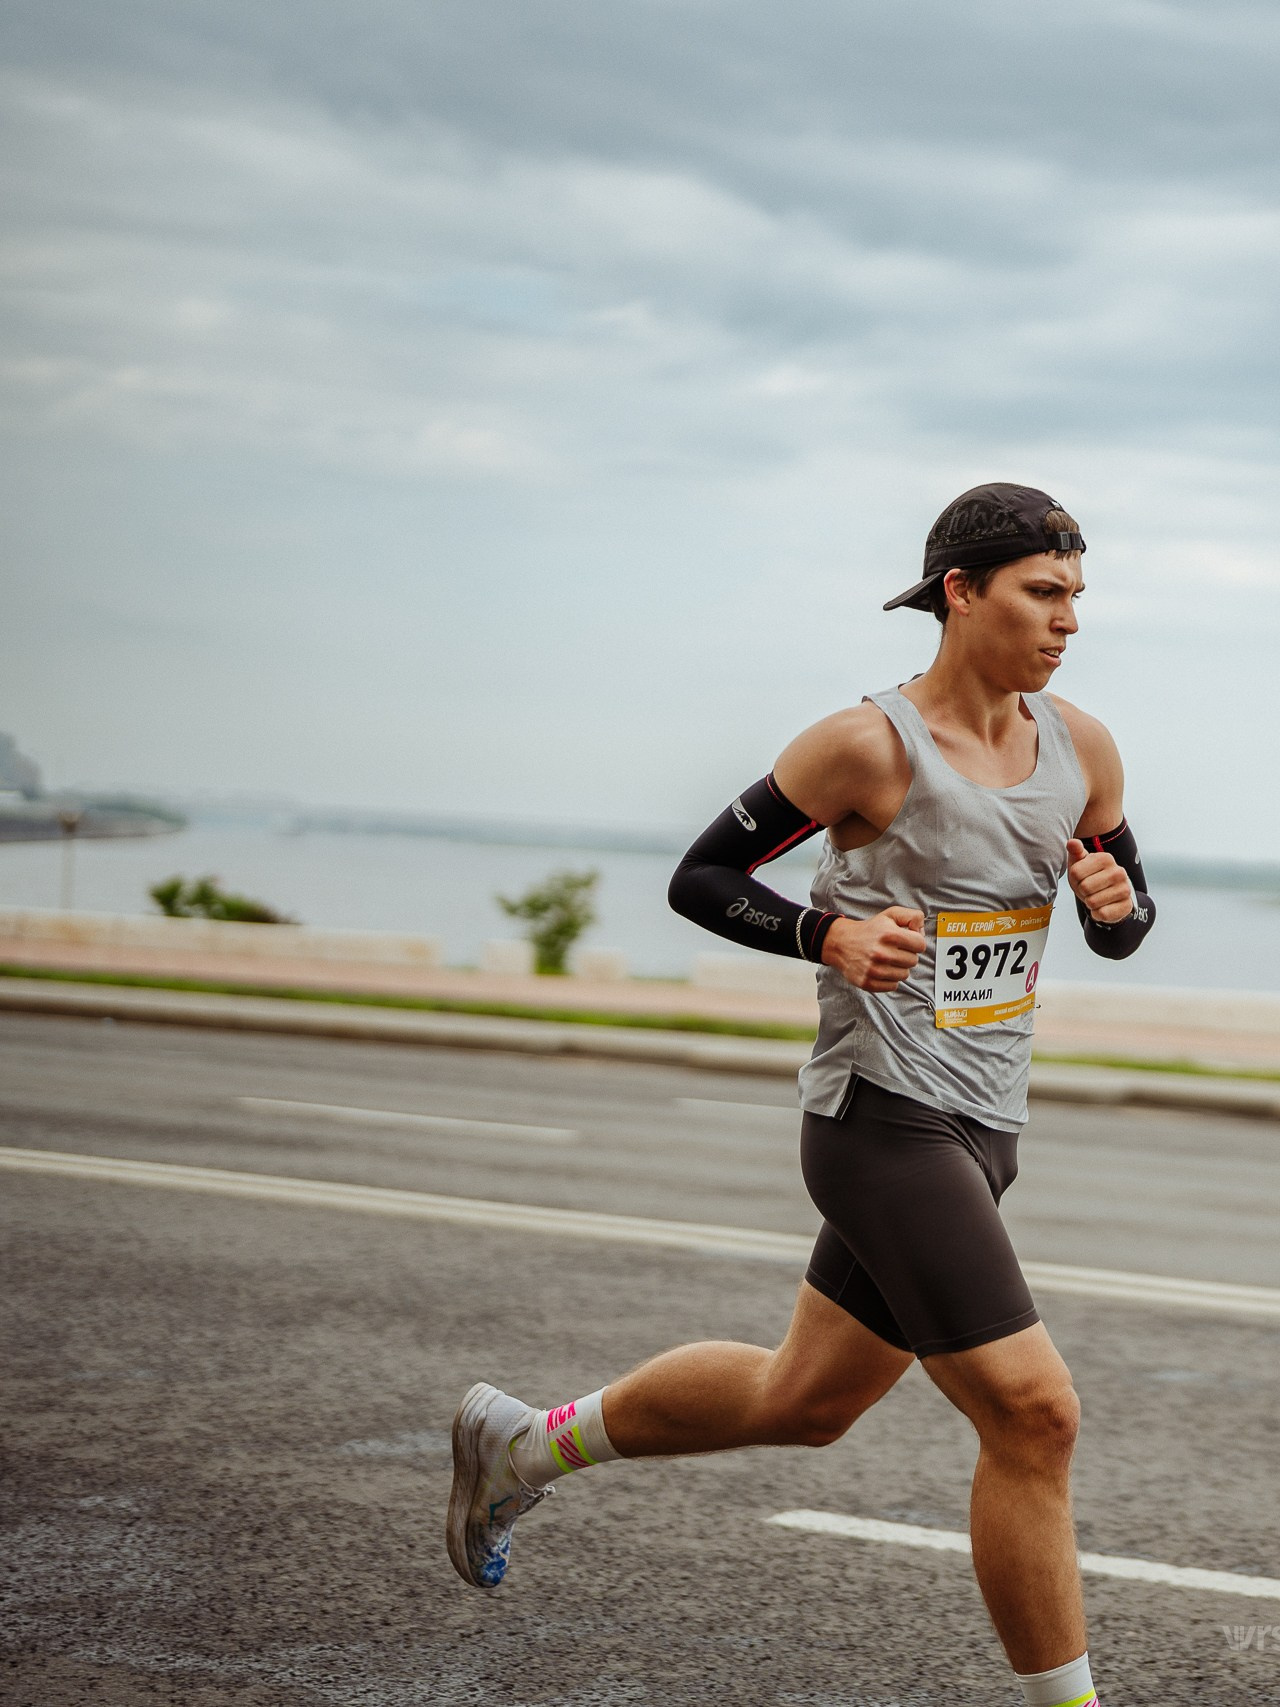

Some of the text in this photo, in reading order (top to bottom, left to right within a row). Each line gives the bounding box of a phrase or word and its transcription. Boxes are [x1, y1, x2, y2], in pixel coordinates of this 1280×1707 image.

[743, 907, 782, 931] asics
[946, 919, 996, 934] БЕГИ, ГЕРОЙ!
[945, 939, 1028, 980] 3972
[943, 988, 993, 1002] МИХАИЛ
